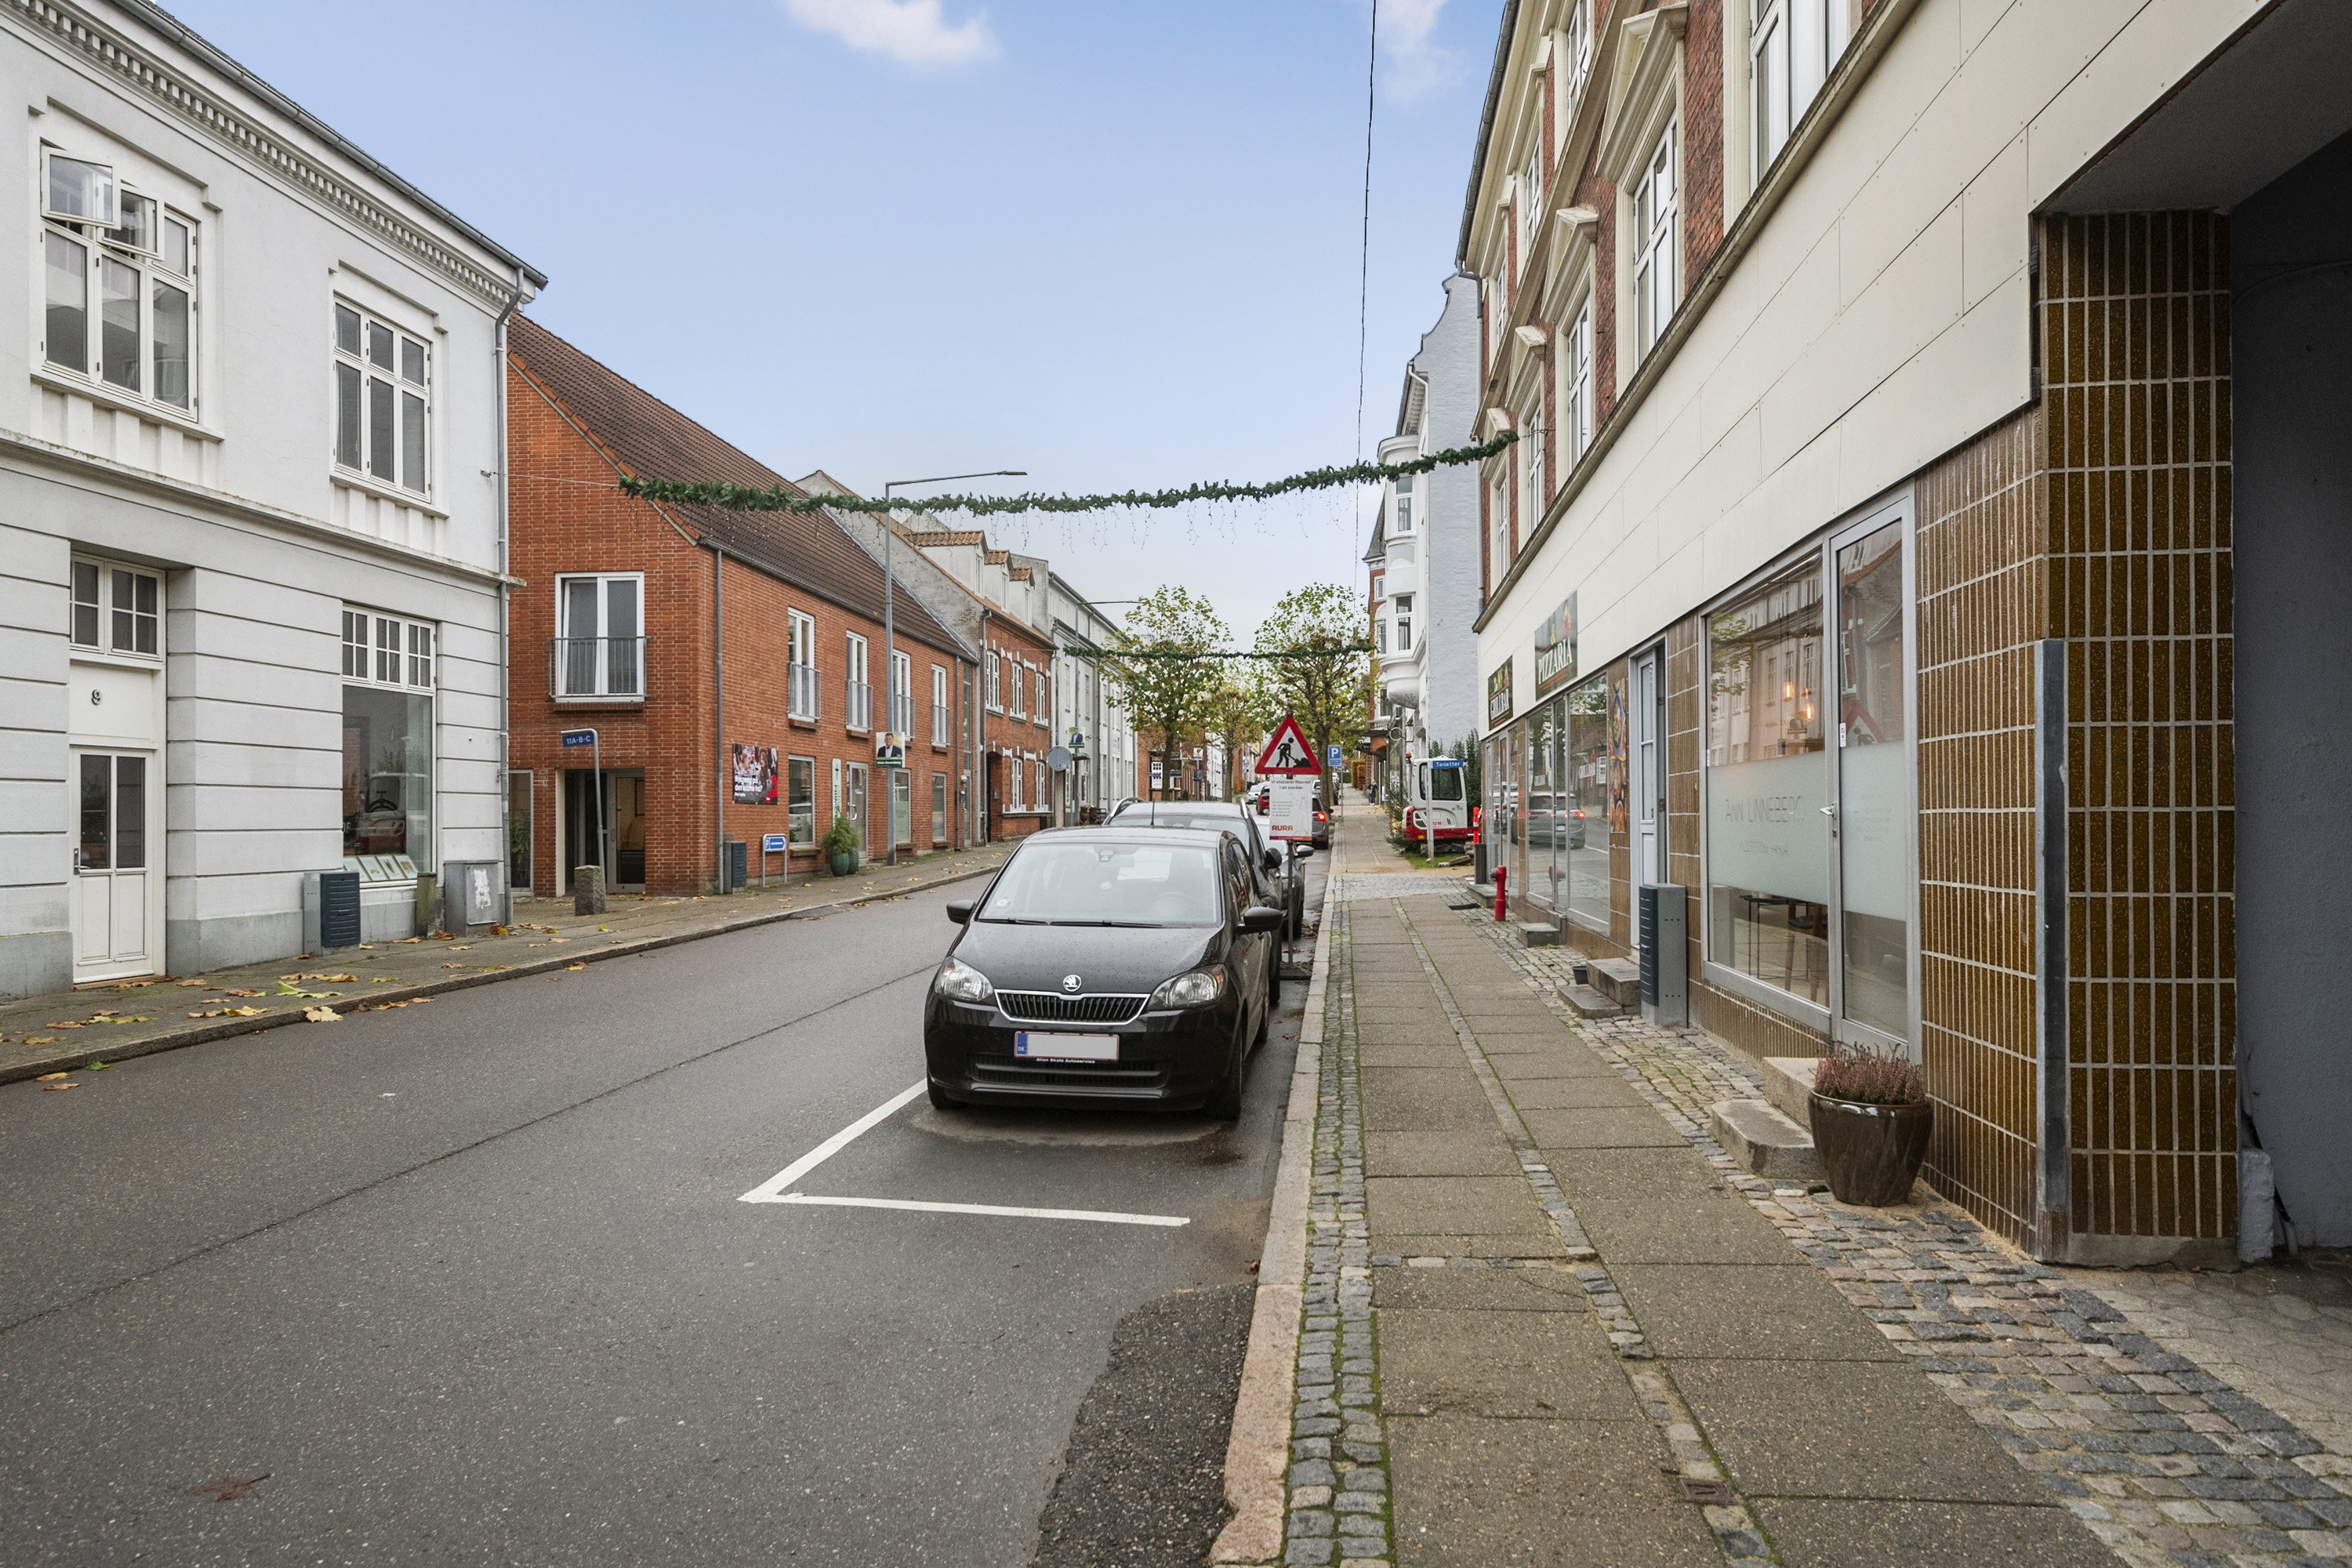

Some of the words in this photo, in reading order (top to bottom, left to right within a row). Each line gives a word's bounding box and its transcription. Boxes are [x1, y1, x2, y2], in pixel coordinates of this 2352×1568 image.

[1537, 636, 1573, 685] PIZZARIA
[91, 689, 101, 706] 9
[1331, 748, 1339, 758] P
